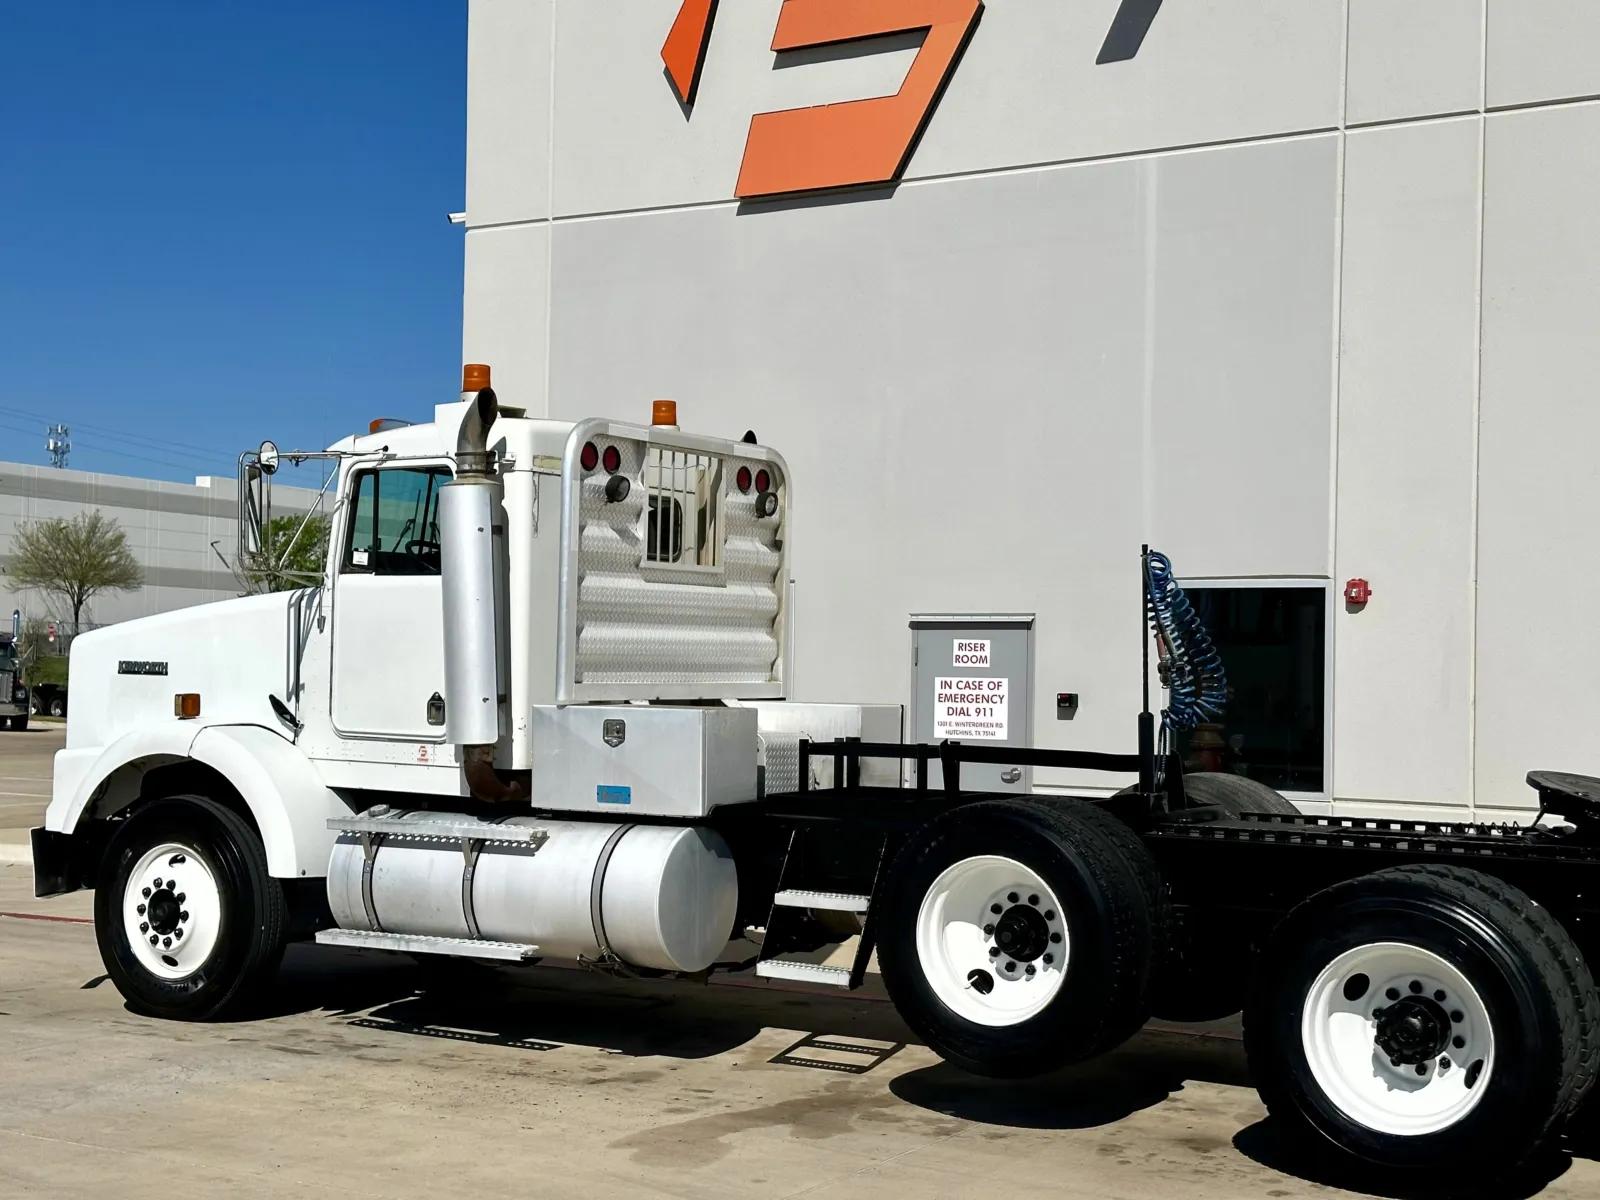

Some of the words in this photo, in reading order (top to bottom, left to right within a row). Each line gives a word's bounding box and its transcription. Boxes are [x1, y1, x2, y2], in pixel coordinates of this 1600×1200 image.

[957, 642, 986, 652] RISER
[954, 654, 988, 664] ROOM
[940, 680, 952, 690] IN
[956, 680, 983, 691] CASE
[987, 681, 1003, 691] OF
[938, 693, 1005, 704] EMERGENCY
[946, 706, 971, 717] DIAL
[975, 707, 994, 717] 911
